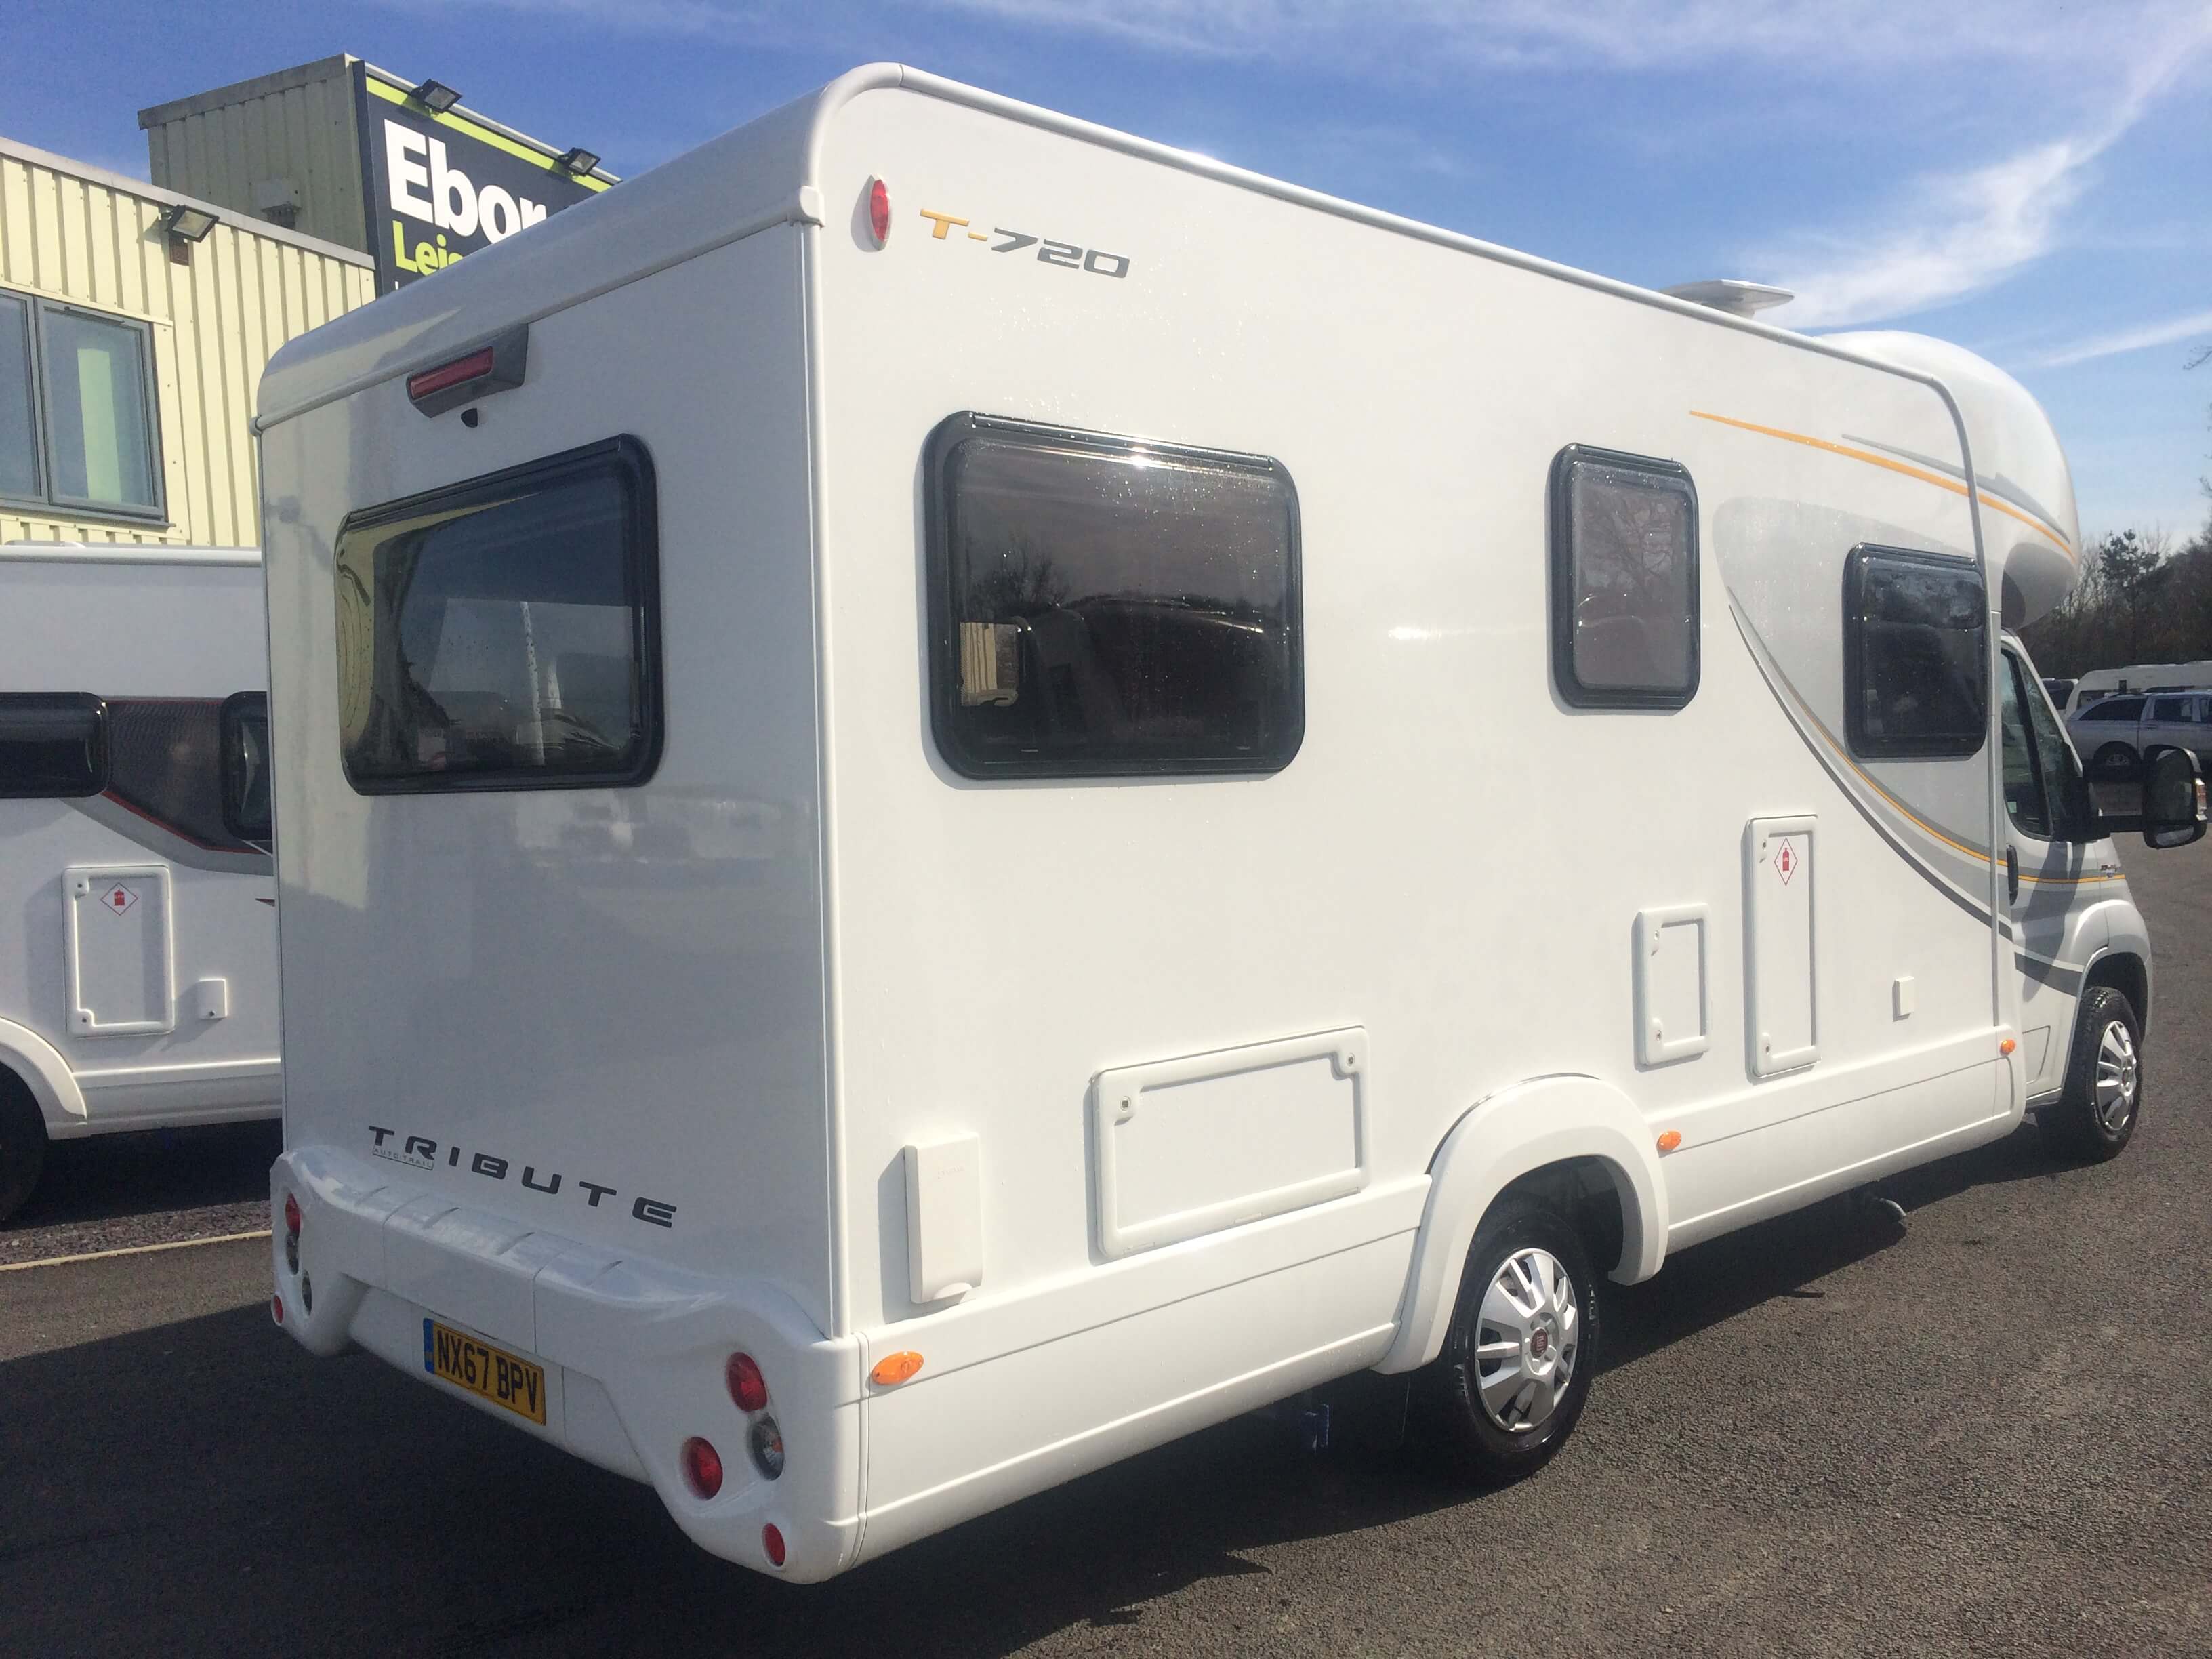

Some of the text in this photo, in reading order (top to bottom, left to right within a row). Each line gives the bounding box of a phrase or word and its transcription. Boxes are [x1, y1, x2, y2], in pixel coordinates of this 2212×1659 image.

[920, 208, 1130, 279] T-720
[368, 1125, 677, 1228] TRIBUTE
[436, 1330, 537, 1414] NX67 BPV
